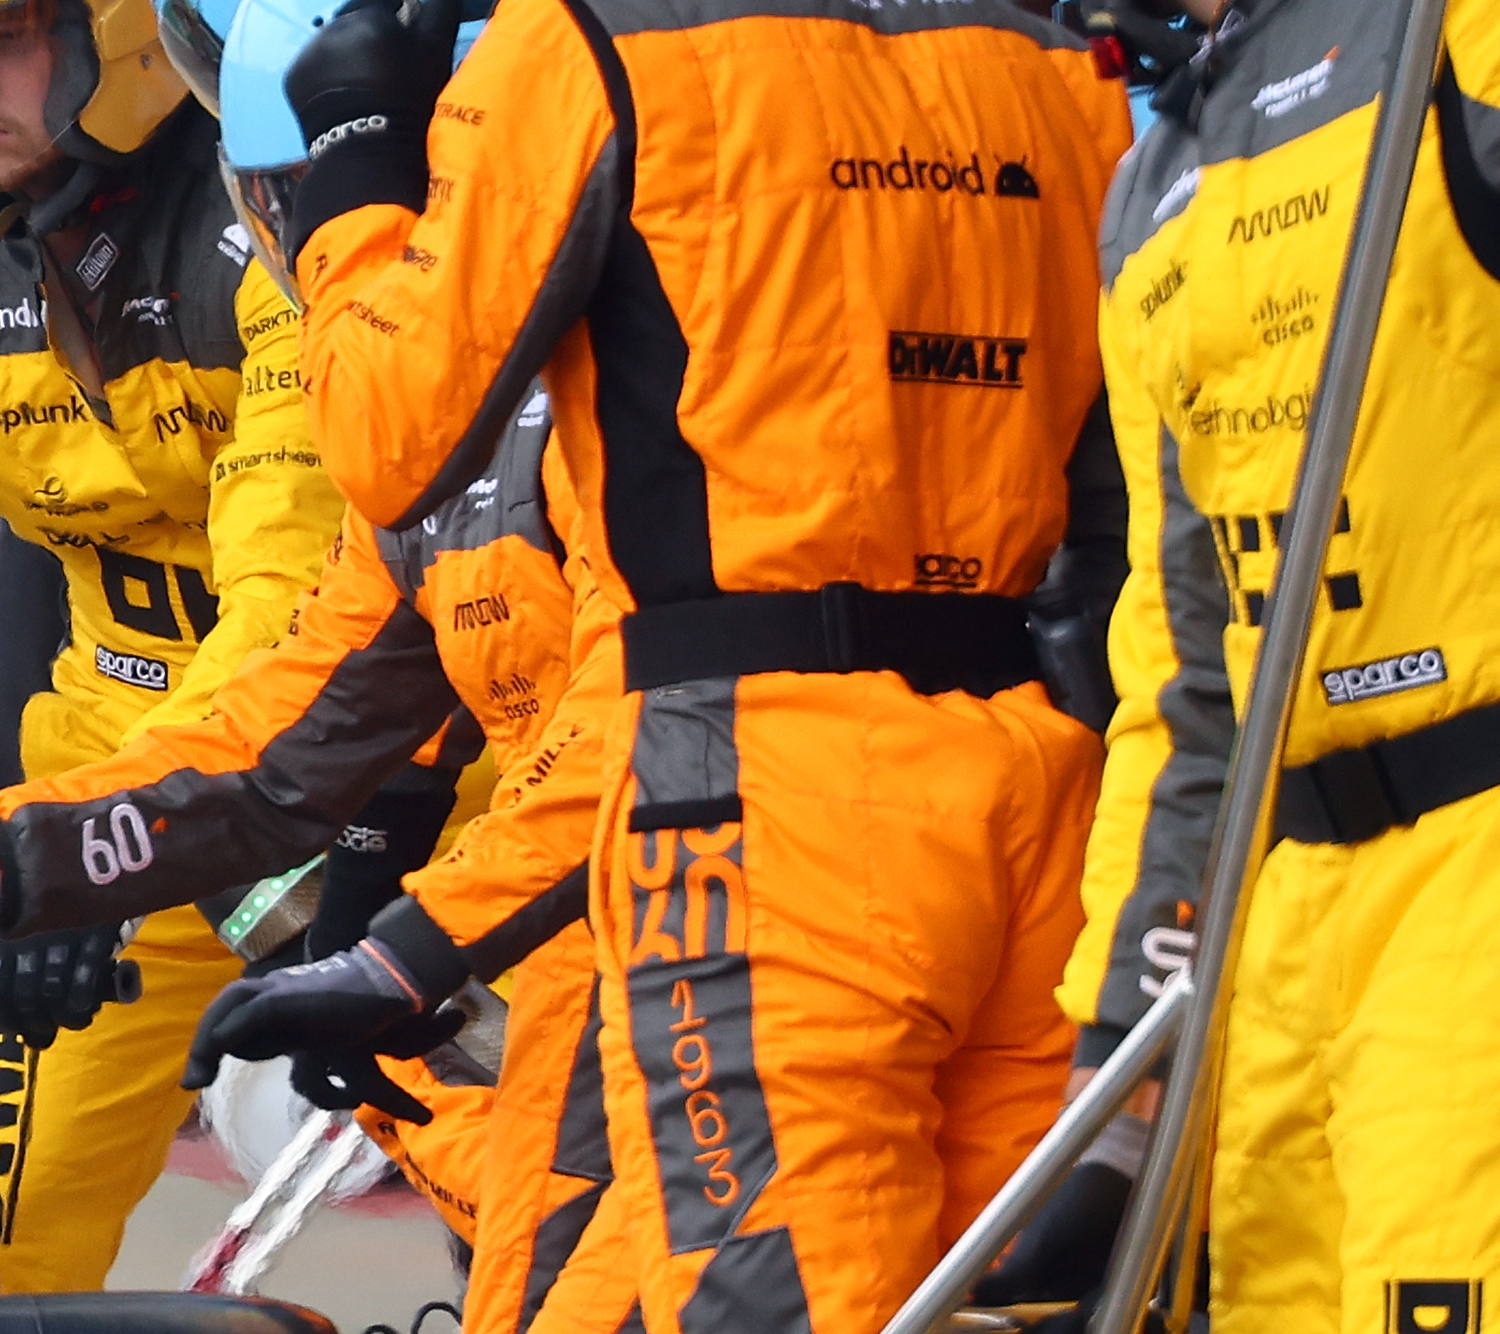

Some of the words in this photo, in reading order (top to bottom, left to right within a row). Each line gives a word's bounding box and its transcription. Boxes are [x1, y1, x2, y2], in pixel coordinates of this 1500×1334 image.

[832, 146, 985, 197] android
[1261, 314, 1315, 347] cisco
[97, 645, 168, 690] sparco
[1323, 651, 1446, 708] sparco
[81, 803, 155, 885] 60
[666, 980, 740, 1208] 1963
